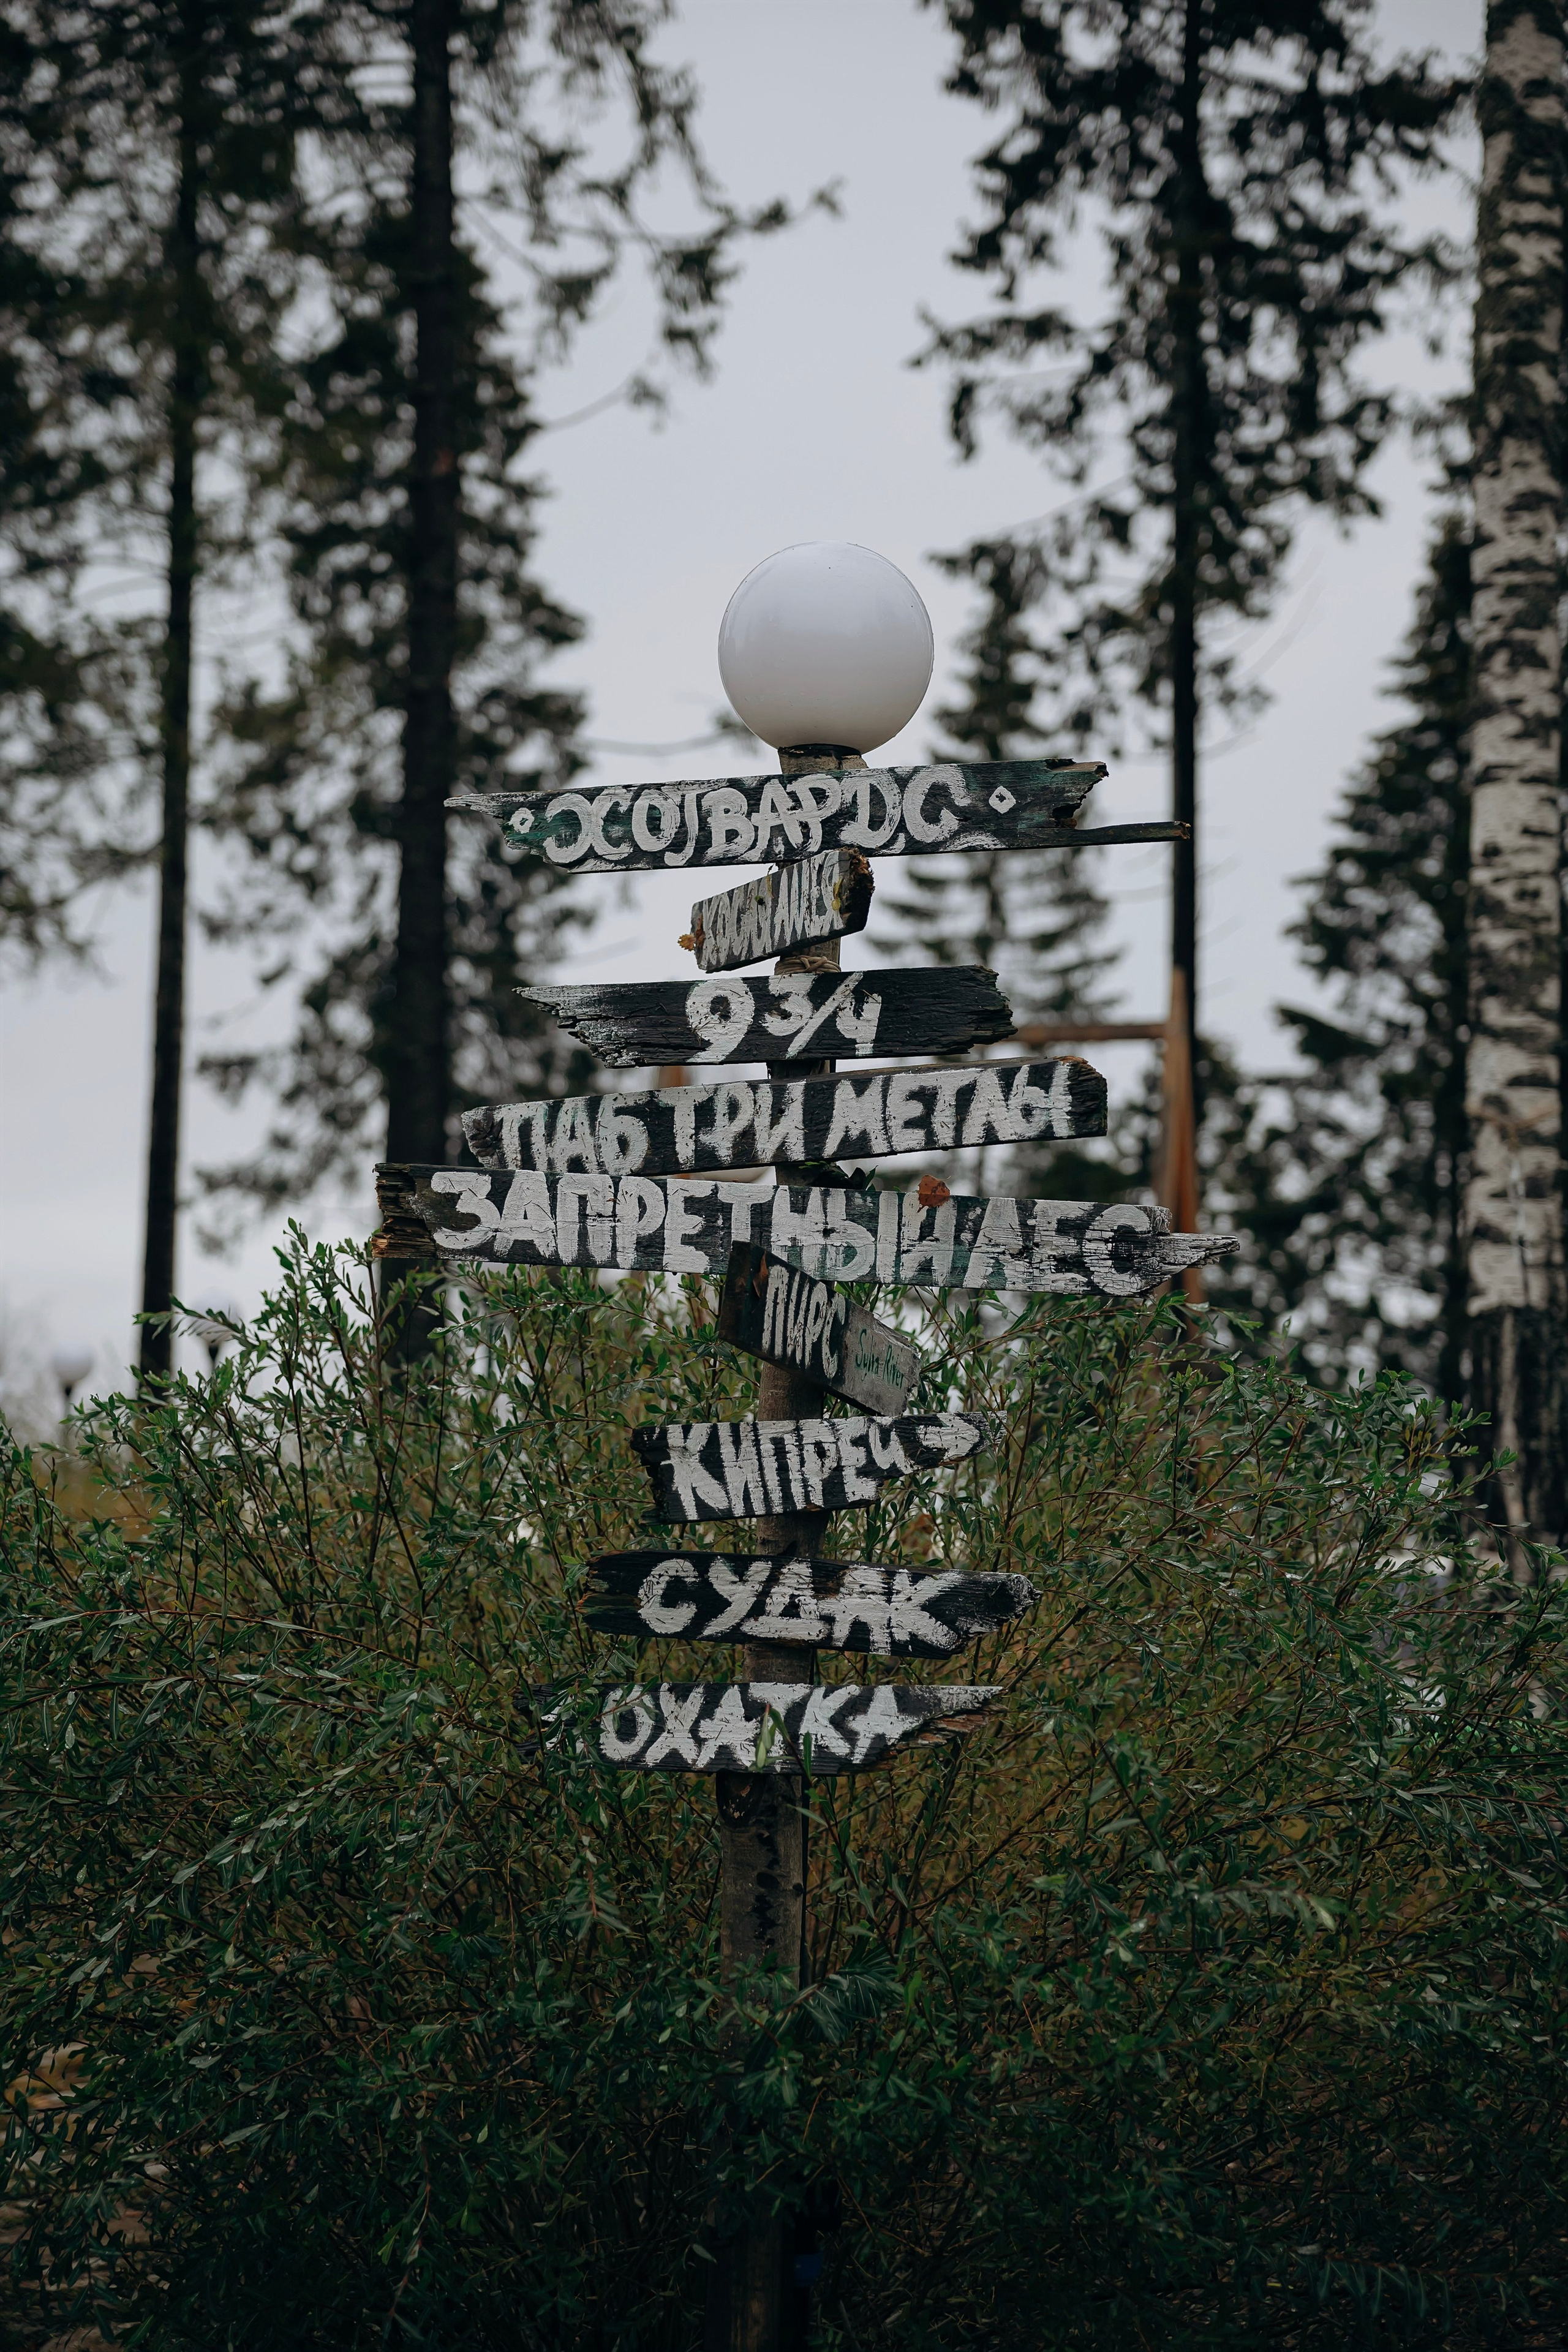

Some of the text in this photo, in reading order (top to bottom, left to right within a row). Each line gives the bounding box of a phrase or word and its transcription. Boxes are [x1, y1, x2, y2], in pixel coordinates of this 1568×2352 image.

[492, 1061, 1072, 1174] ПАБ ТРИ МЕТЛЫ
[763, 1264, 845, 1378] ПИРС
[638, 1556, 964, 1655] СУДАК
[541, 1682, 921, 1770] ОХАТКА
